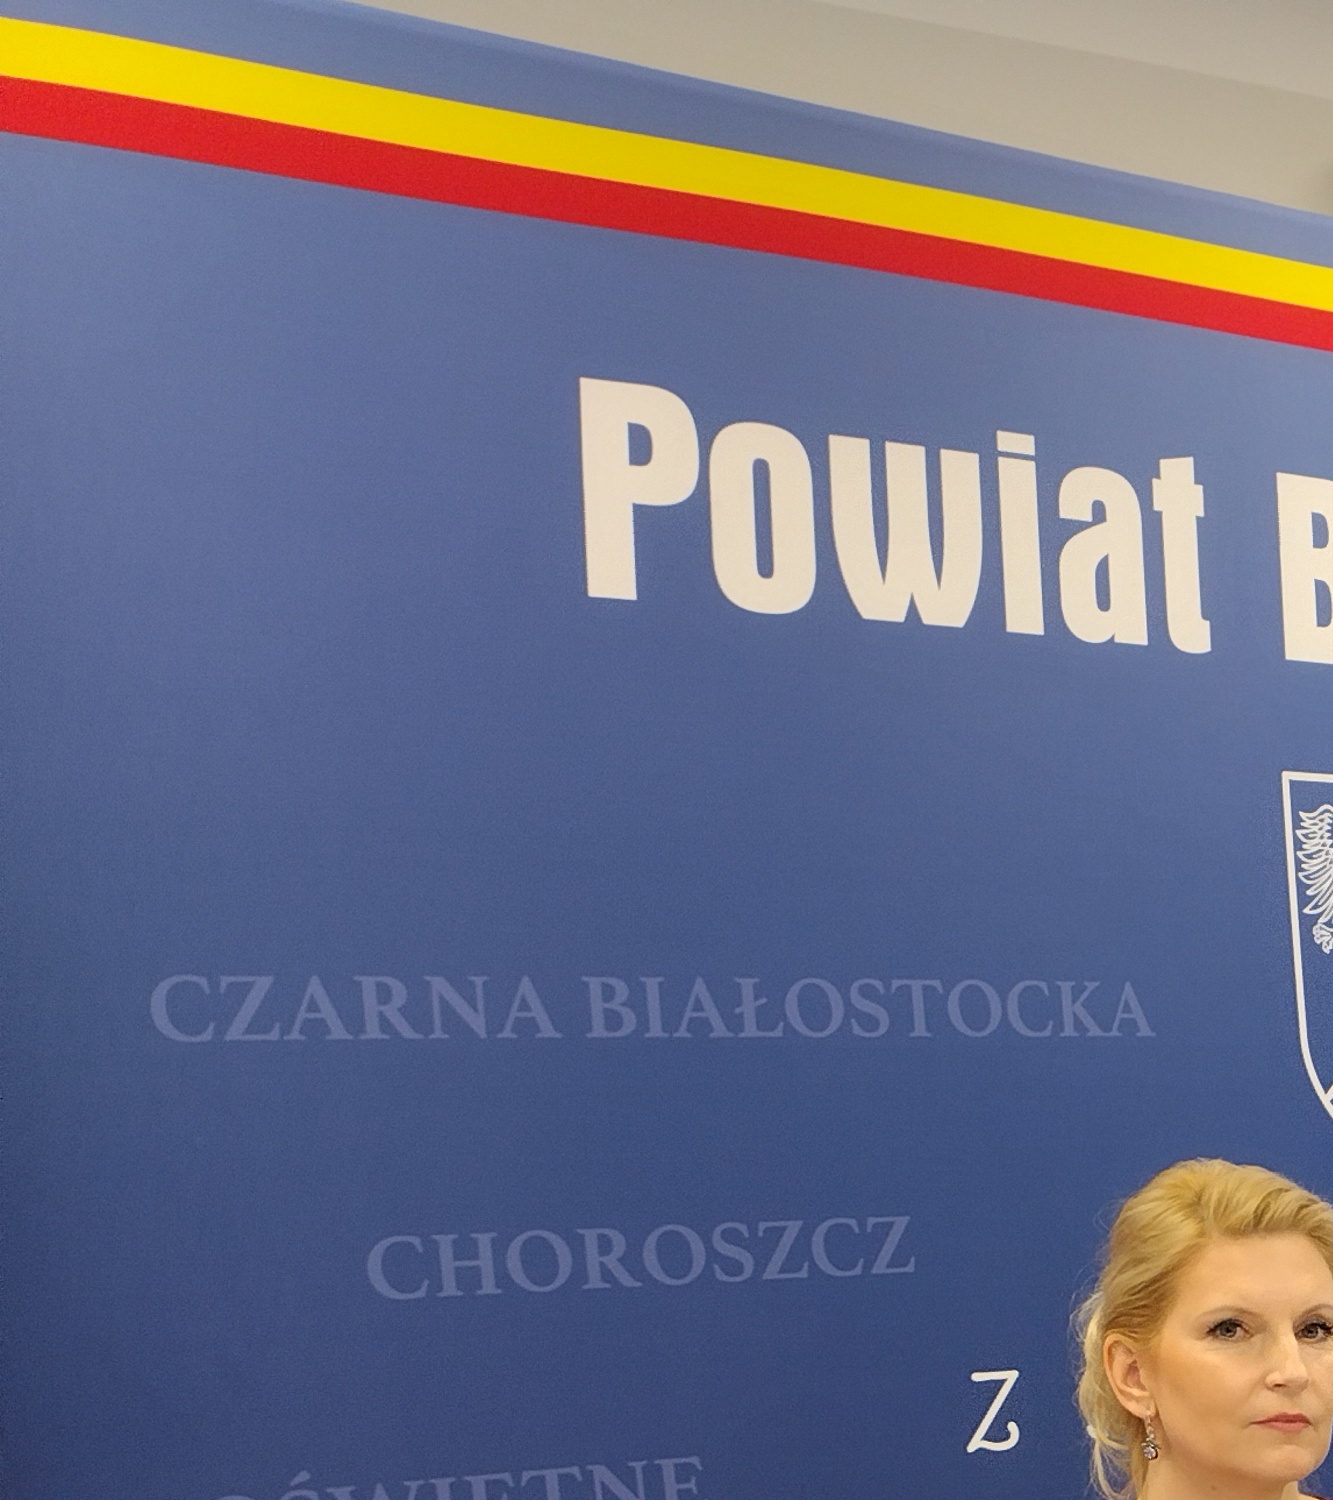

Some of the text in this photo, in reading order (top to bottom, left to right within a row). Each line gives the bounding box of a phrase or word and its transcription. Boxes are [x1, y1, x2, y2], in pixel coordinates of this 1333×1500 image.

[579, 377, 1212, 654] Powiat
[150, 973, 1156, 1042] CZARNA BIAŁOSTOCKA
[366, 1214, 916, 1301] CHOROSZCZ
[966, 1369, 1020, 1454] z
